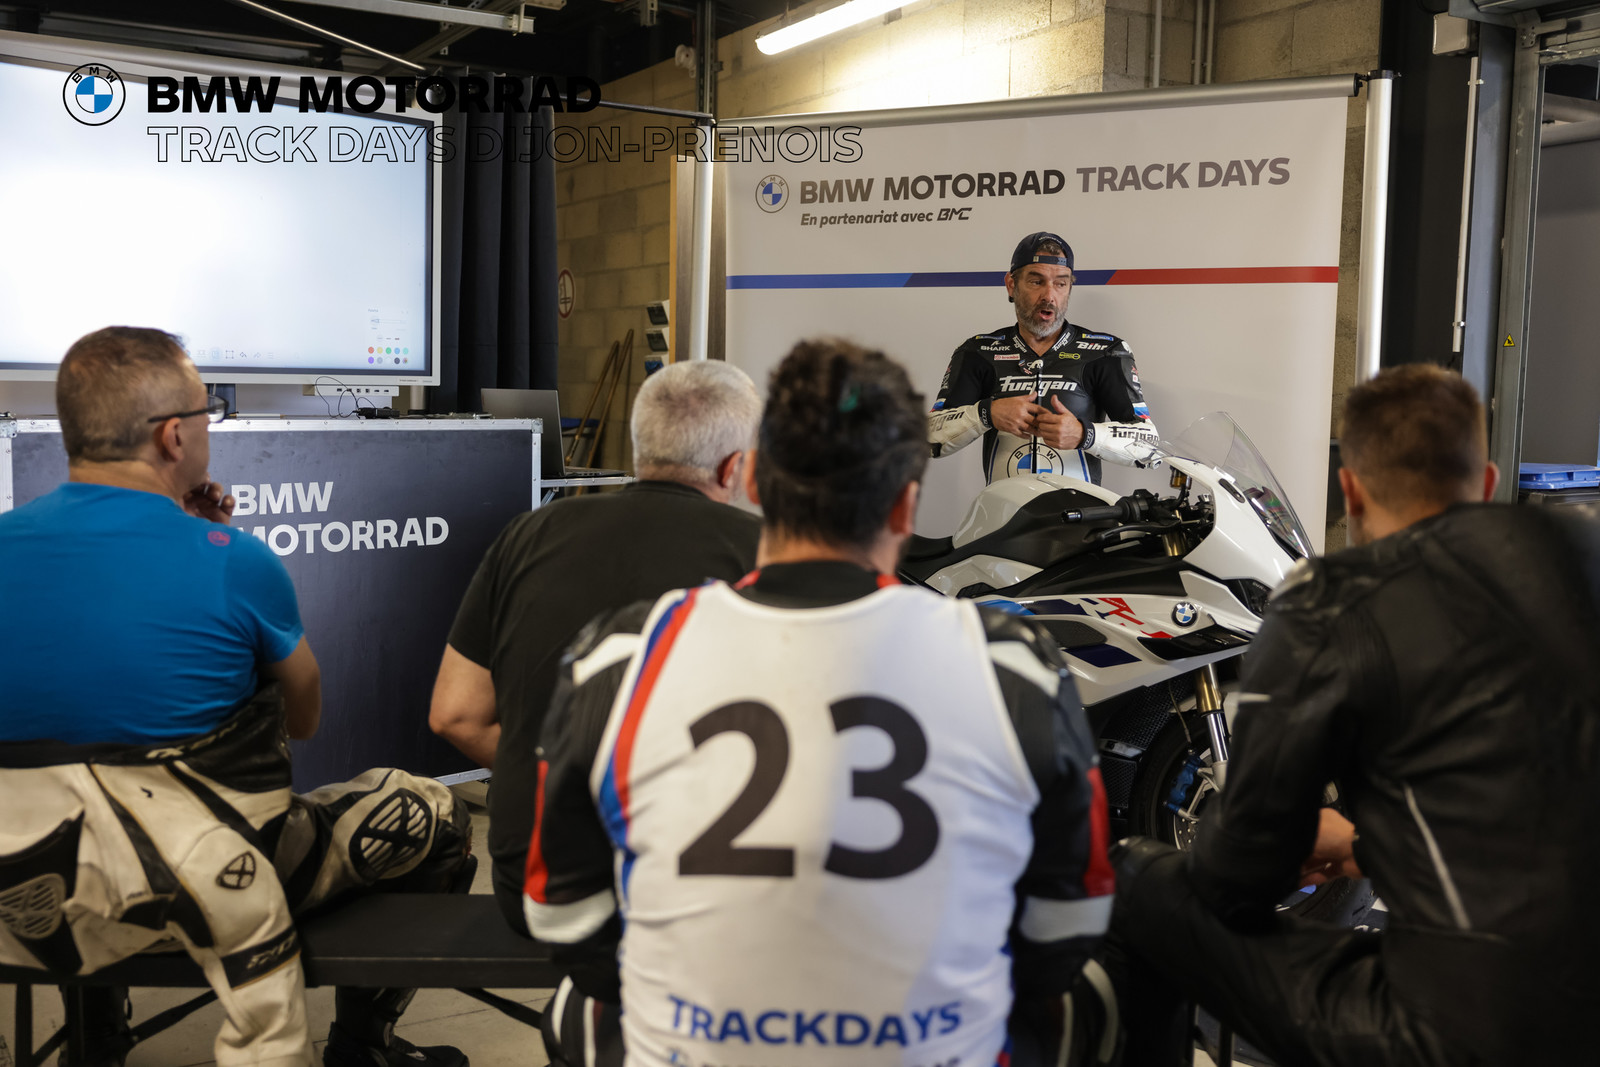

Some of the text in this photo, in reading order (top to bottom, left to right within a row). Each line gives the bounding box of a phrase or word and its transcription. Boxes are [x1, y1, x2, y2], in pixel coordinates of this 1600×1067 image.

[799, 157, 1291, 204] BMW MOTORRAD TRACK DAYS
[800, 207, 973, 228] En partenariat avec BMC
[1076, 341, 1108, 350] Bihr
[231, 481, 334, 516] BMW
[678, 695, 941, 880] 23
[669, 994, 963, 1047] TRACKDAYS
